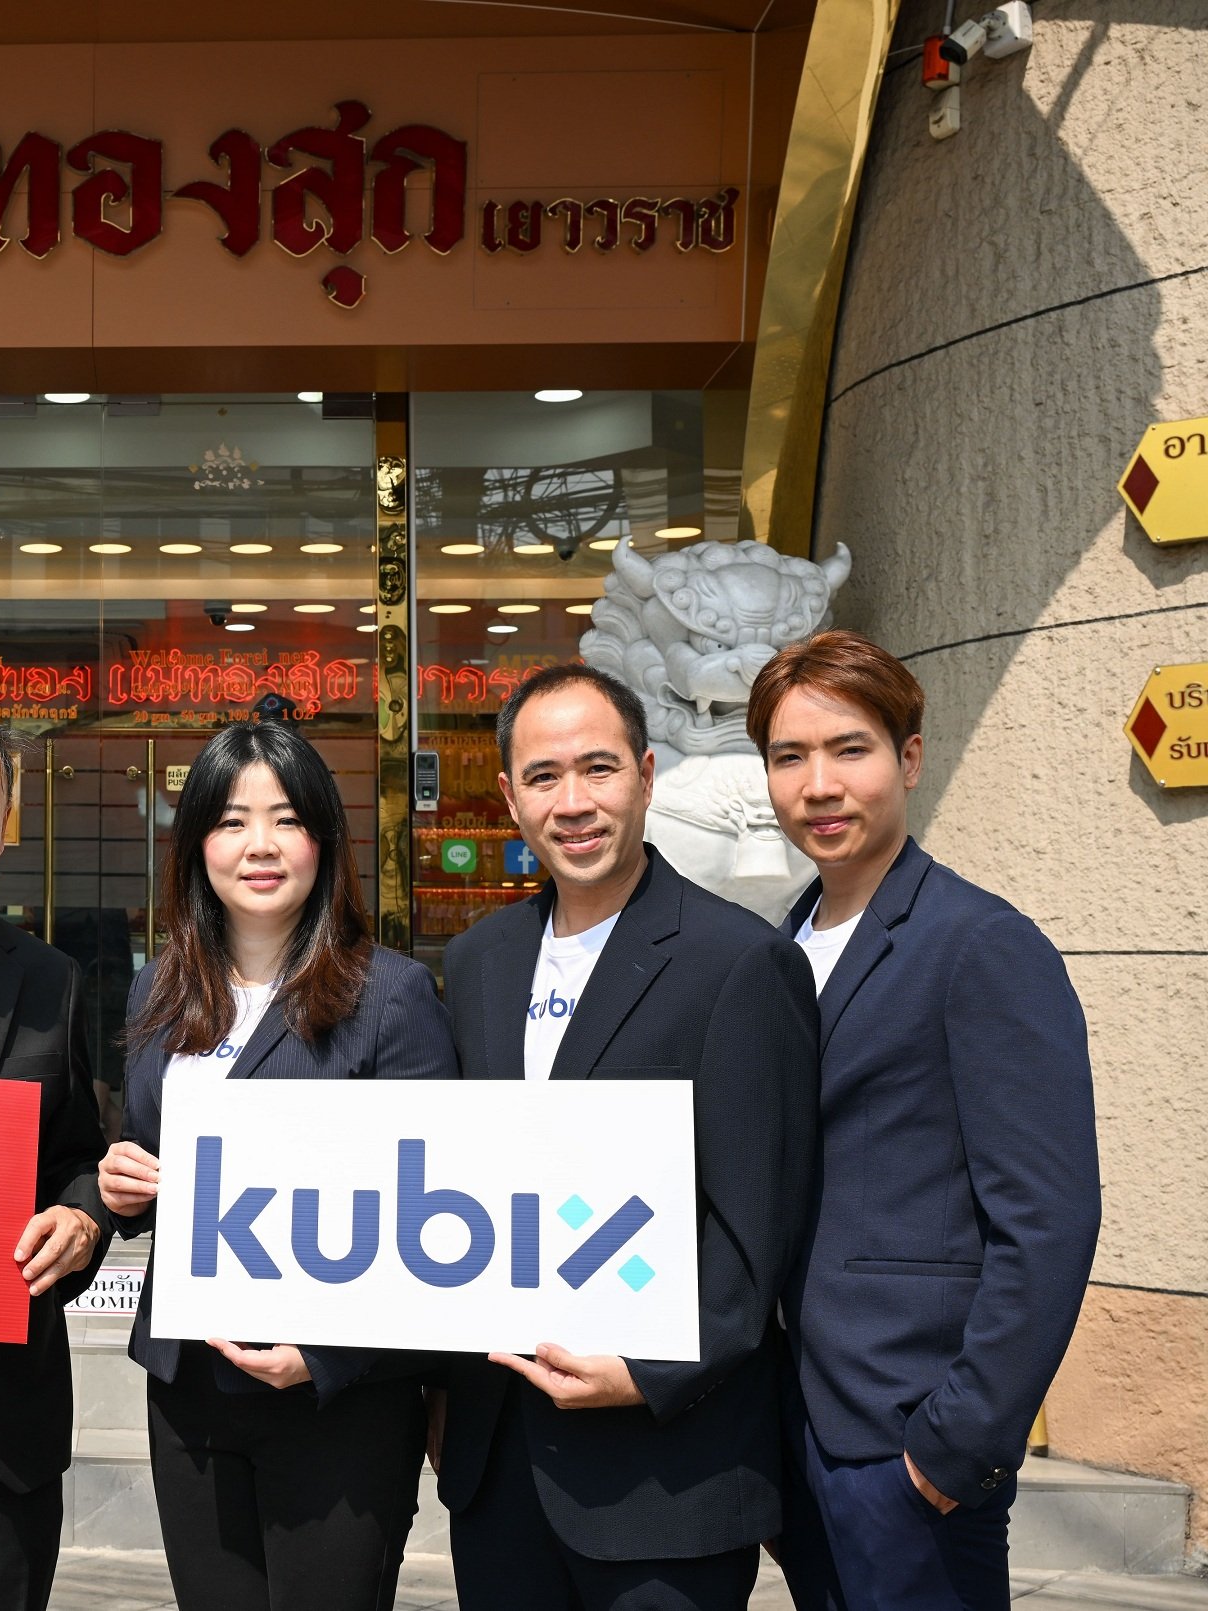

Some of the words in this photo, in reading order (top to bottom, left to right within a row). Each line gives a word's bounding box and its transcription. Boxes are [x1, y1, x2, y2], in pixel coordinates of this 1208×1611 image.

[482, 187, 740, 254] เยาวราช
[451, 849, 468, 859] LINE
